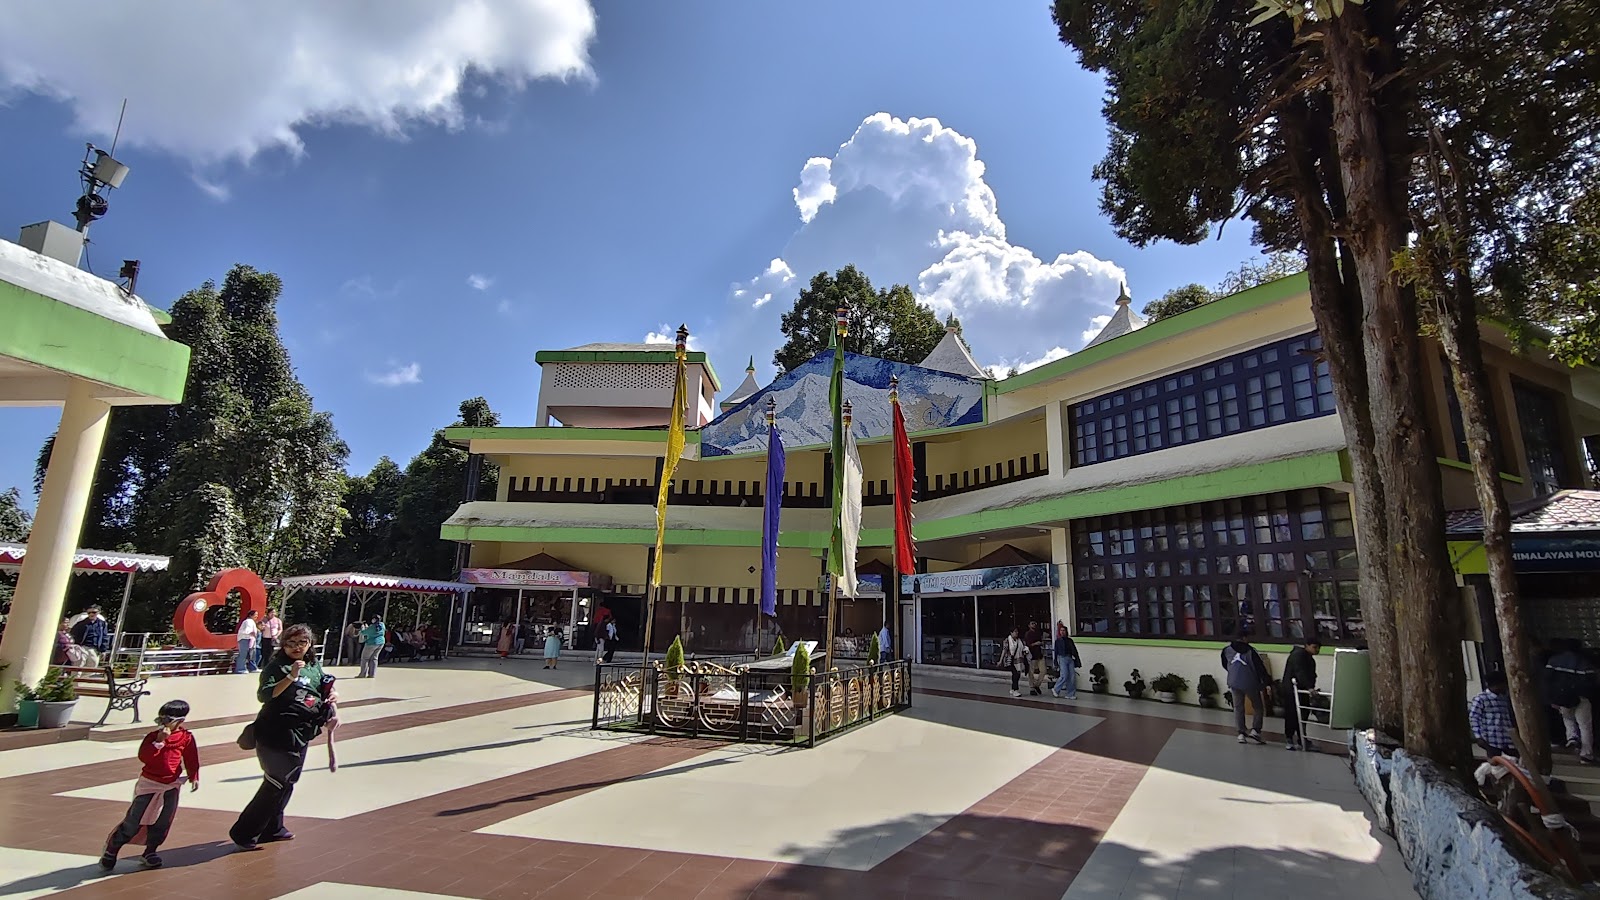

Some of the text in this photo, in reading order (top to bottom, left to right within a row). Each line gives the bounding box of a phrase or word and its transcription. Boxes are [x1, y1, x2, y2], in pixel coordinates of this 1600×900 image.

[492, 571, 560, 580] Mandala
[924, 574, 982, 588] HMI SOUVENIR
